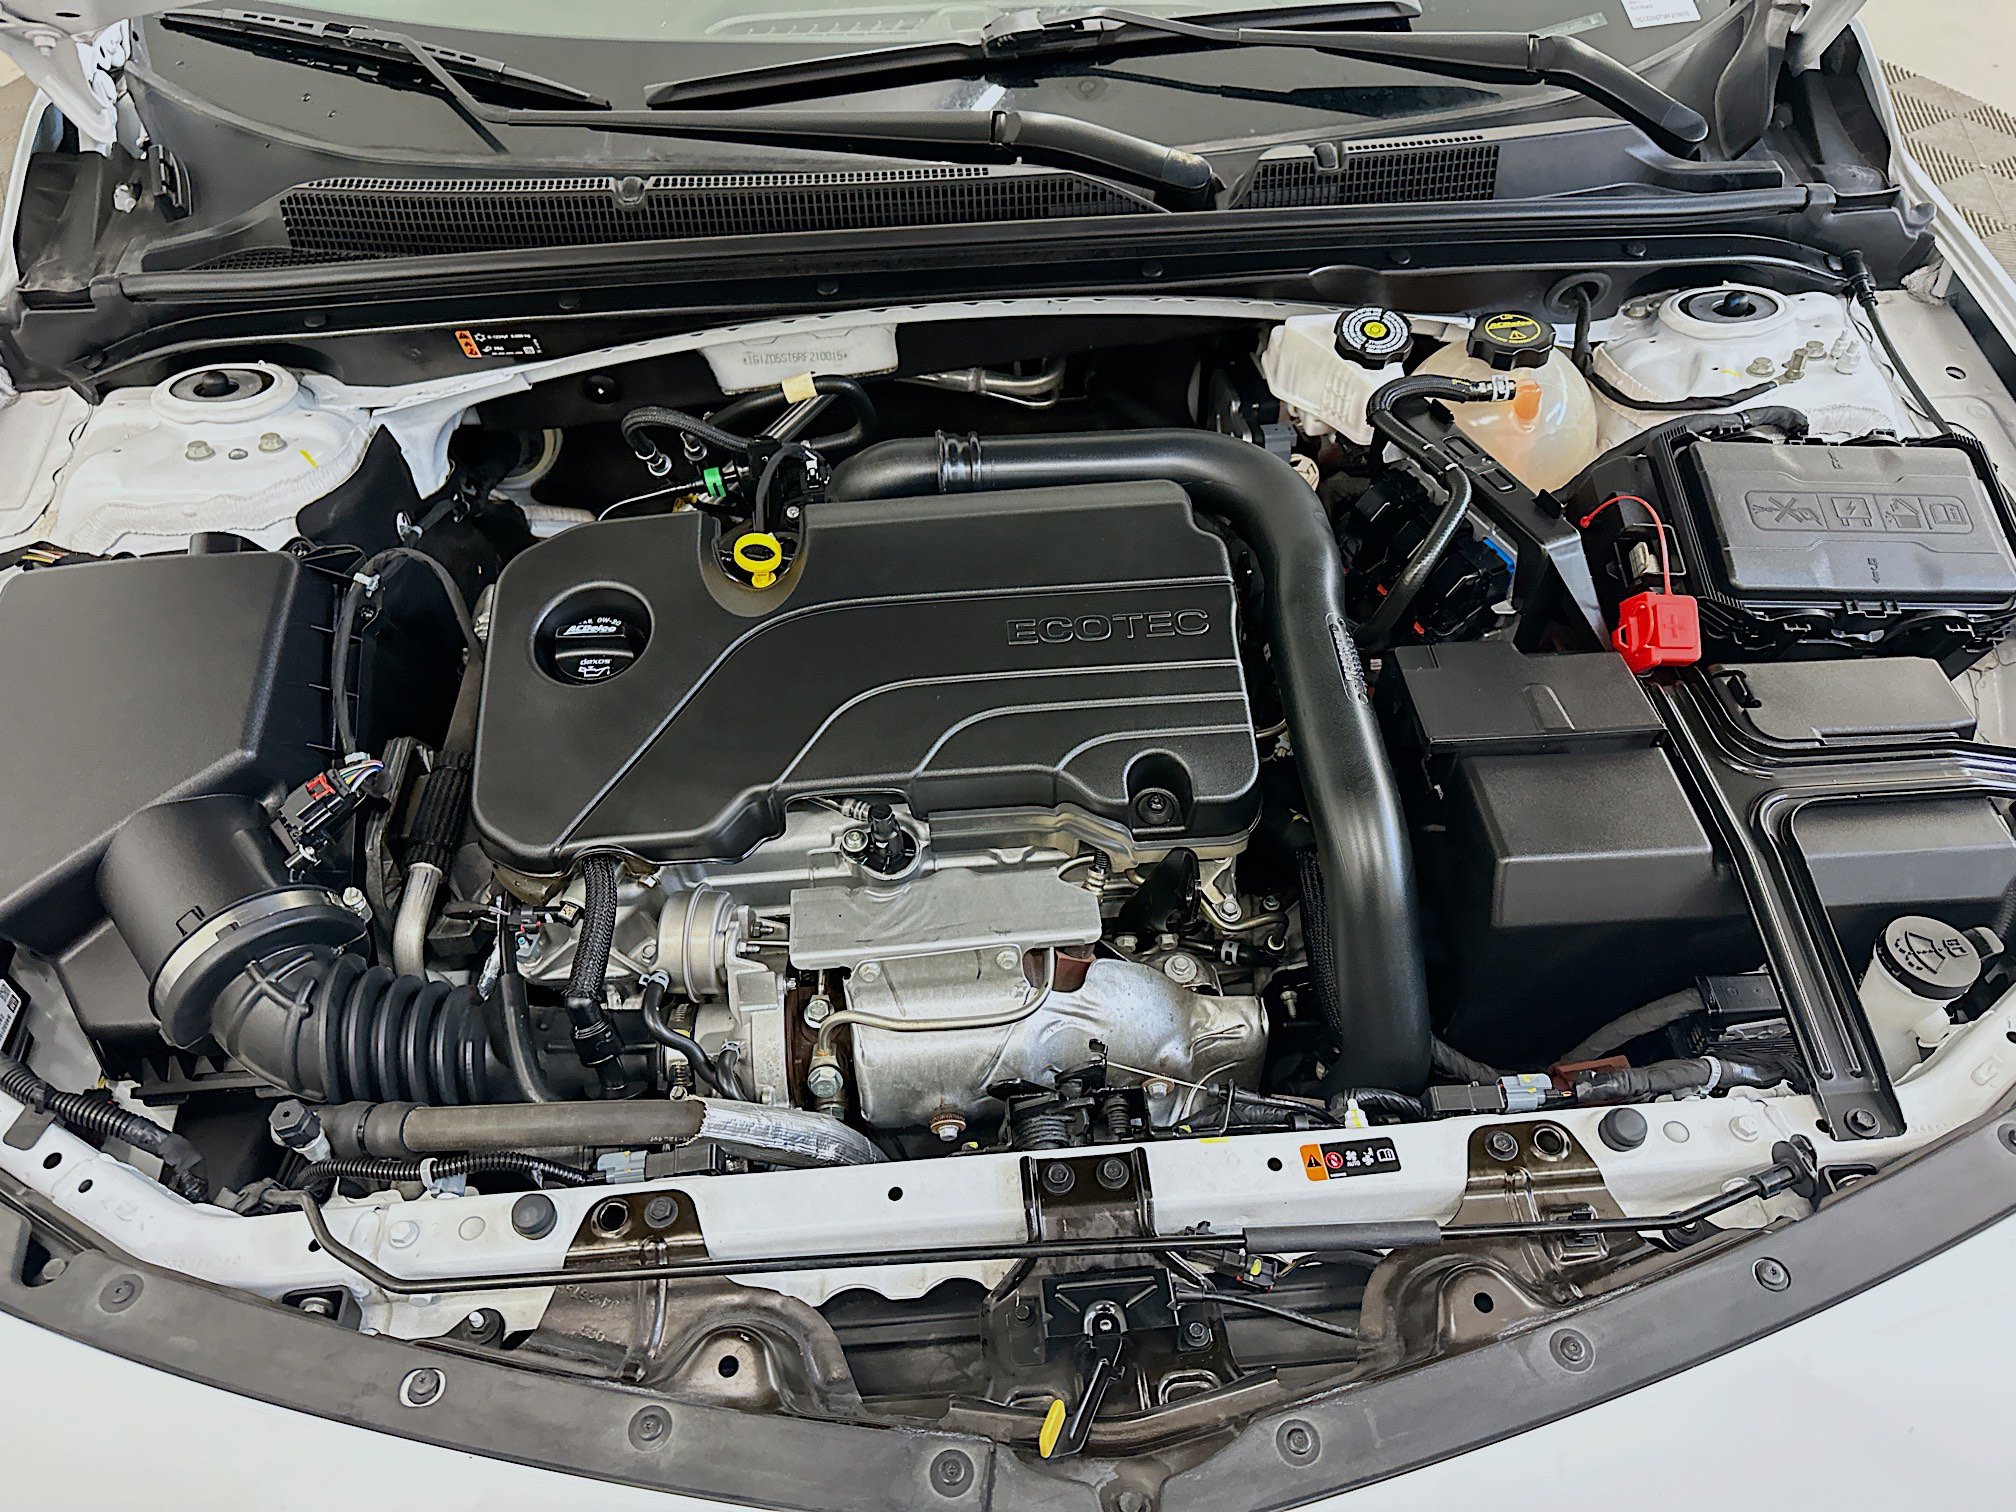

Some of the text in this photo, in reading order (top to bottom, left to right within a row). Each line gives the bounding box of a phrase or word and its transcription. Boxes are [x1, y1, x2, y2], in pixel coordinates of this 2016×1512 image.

[563, 624, 617, 636] ACDelco
[1006, 608, 1210, 646] ECOTEC
[580, 658, 612, 666] dexos
